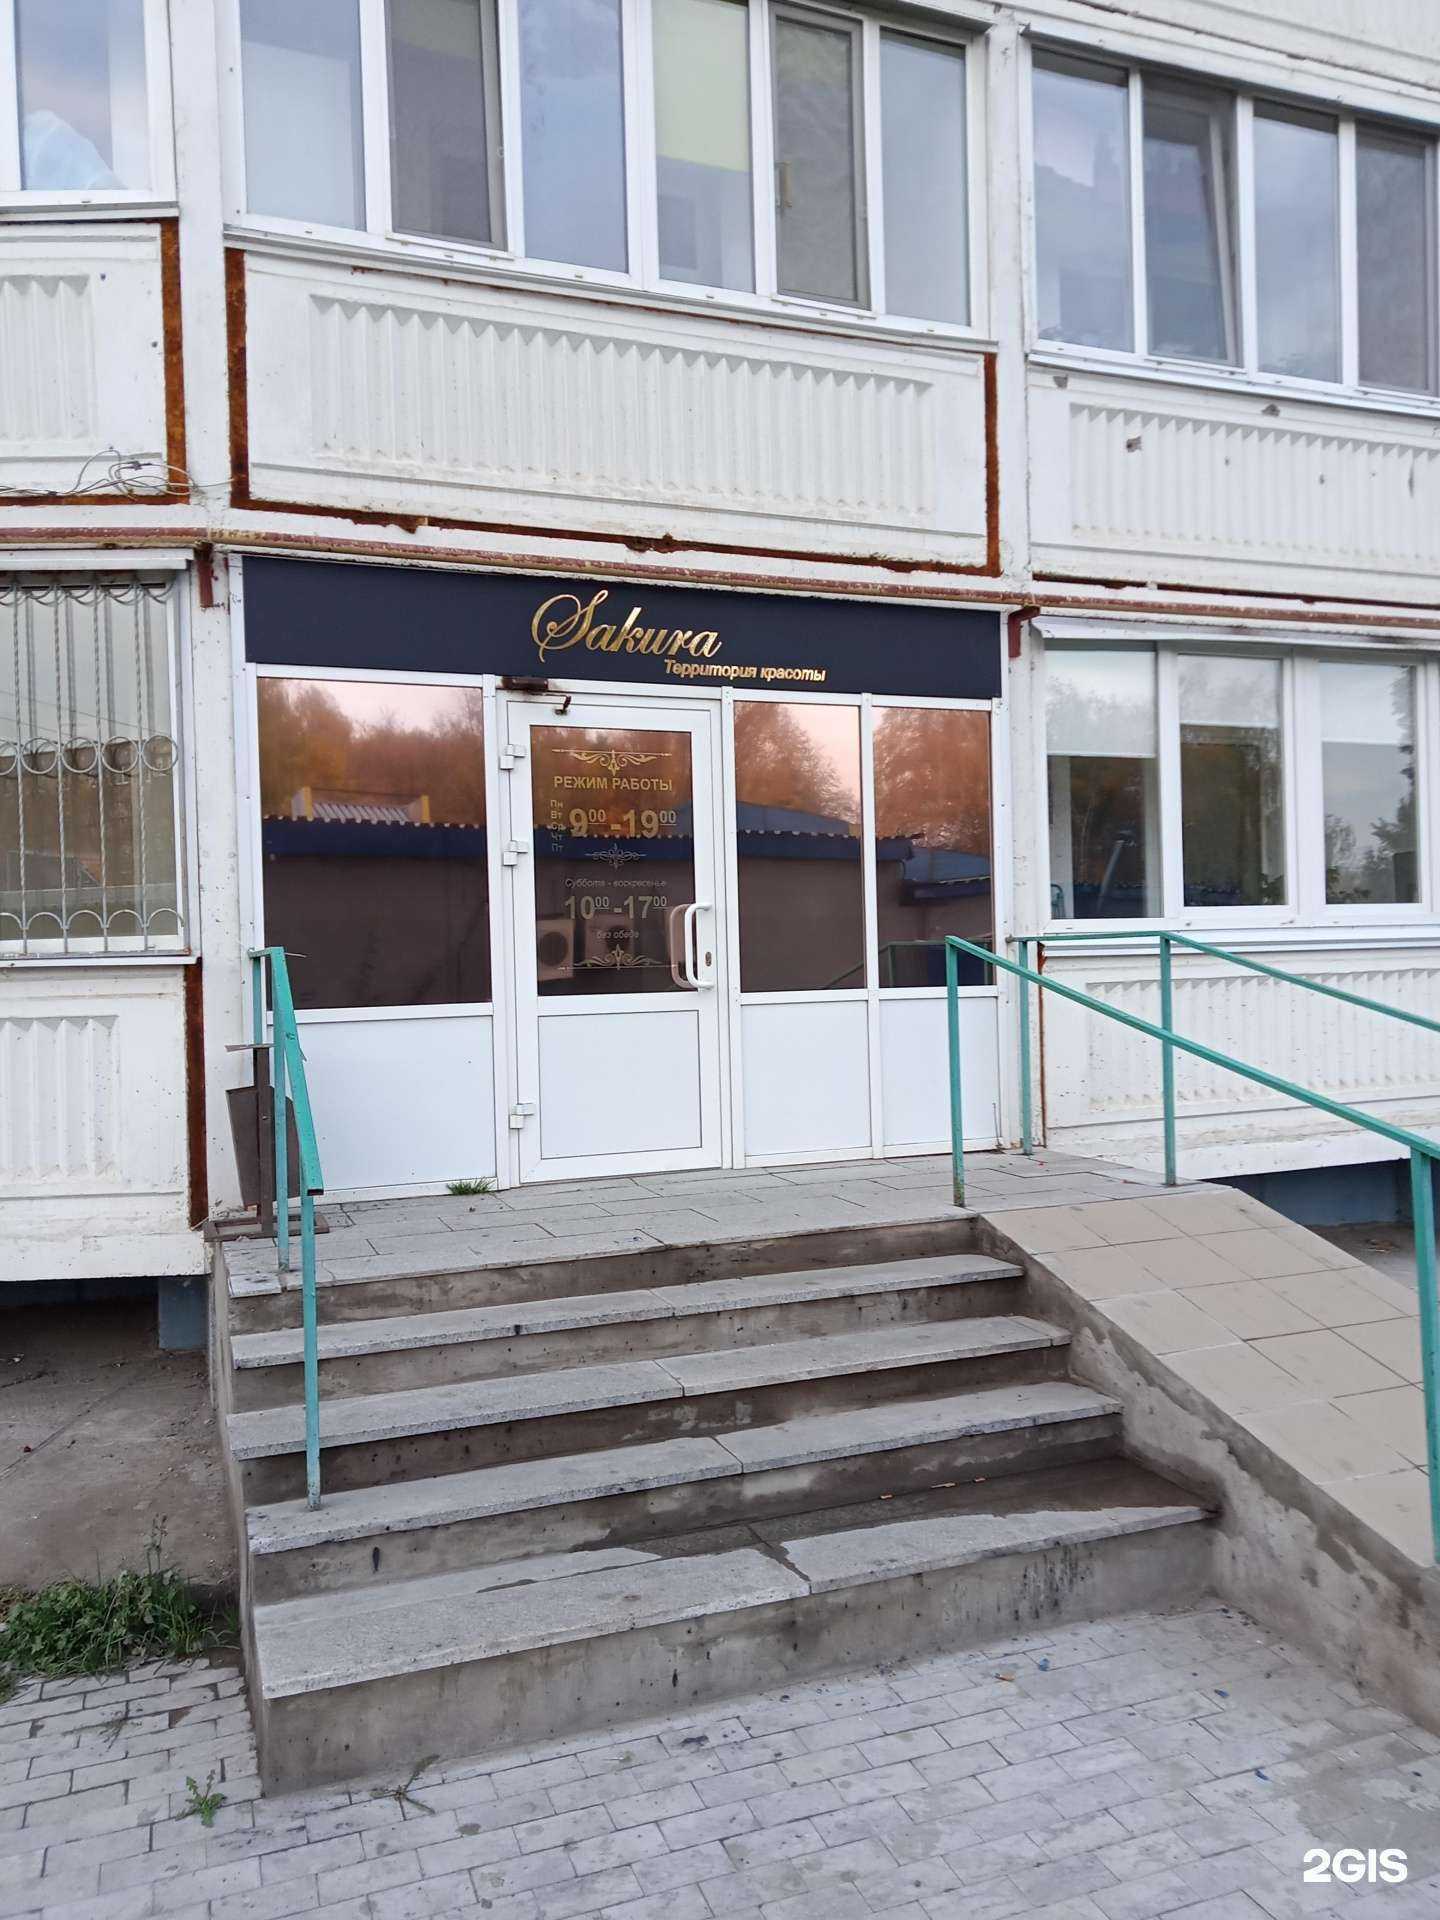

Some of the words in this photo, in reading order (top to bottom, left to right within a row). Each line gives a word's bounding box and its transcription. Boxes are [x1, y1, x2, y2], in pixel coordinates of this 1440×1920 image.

[531, 590, 722, 663] Sakura
[664, 658, 757, 679] Территория
[760, 666, 826, 682] красоты
[553, 775, 608, 789] РЕЖИМ
[612, 777, 673, 792] РАБОТЫ
[550, 799, 563, 809] Пн
[551, 810, 562, 820] Вт
